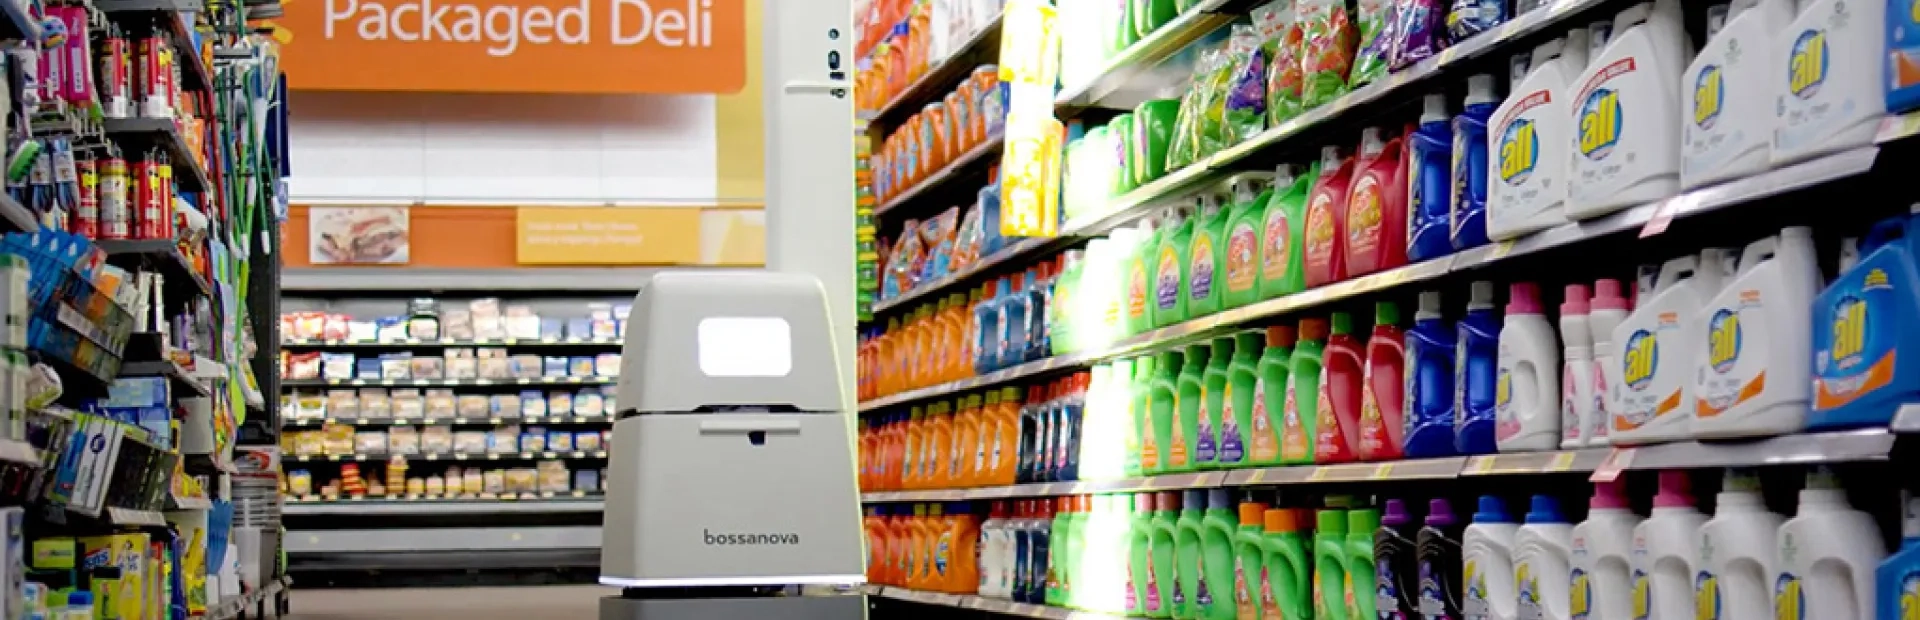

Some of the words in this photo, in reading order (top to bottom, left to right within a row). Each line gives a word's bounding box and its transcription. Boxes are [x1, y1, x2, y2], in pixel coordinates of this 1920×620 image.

[325, 0, 590, 56] Packaged
[611, 0, 712, 47] Deli
[1791, 31, 1826, 95] all
[1580, 91, 1618, 154] all
[1695, 66, 1721, 125] all
[1501, 121, 1535, 181] all
[1624, 334, 1656, 386] all
[1710, 314, 1738, 366] all
[1833, 301, 1866, 361] all
[703, 528, 799, 545] bossanova
